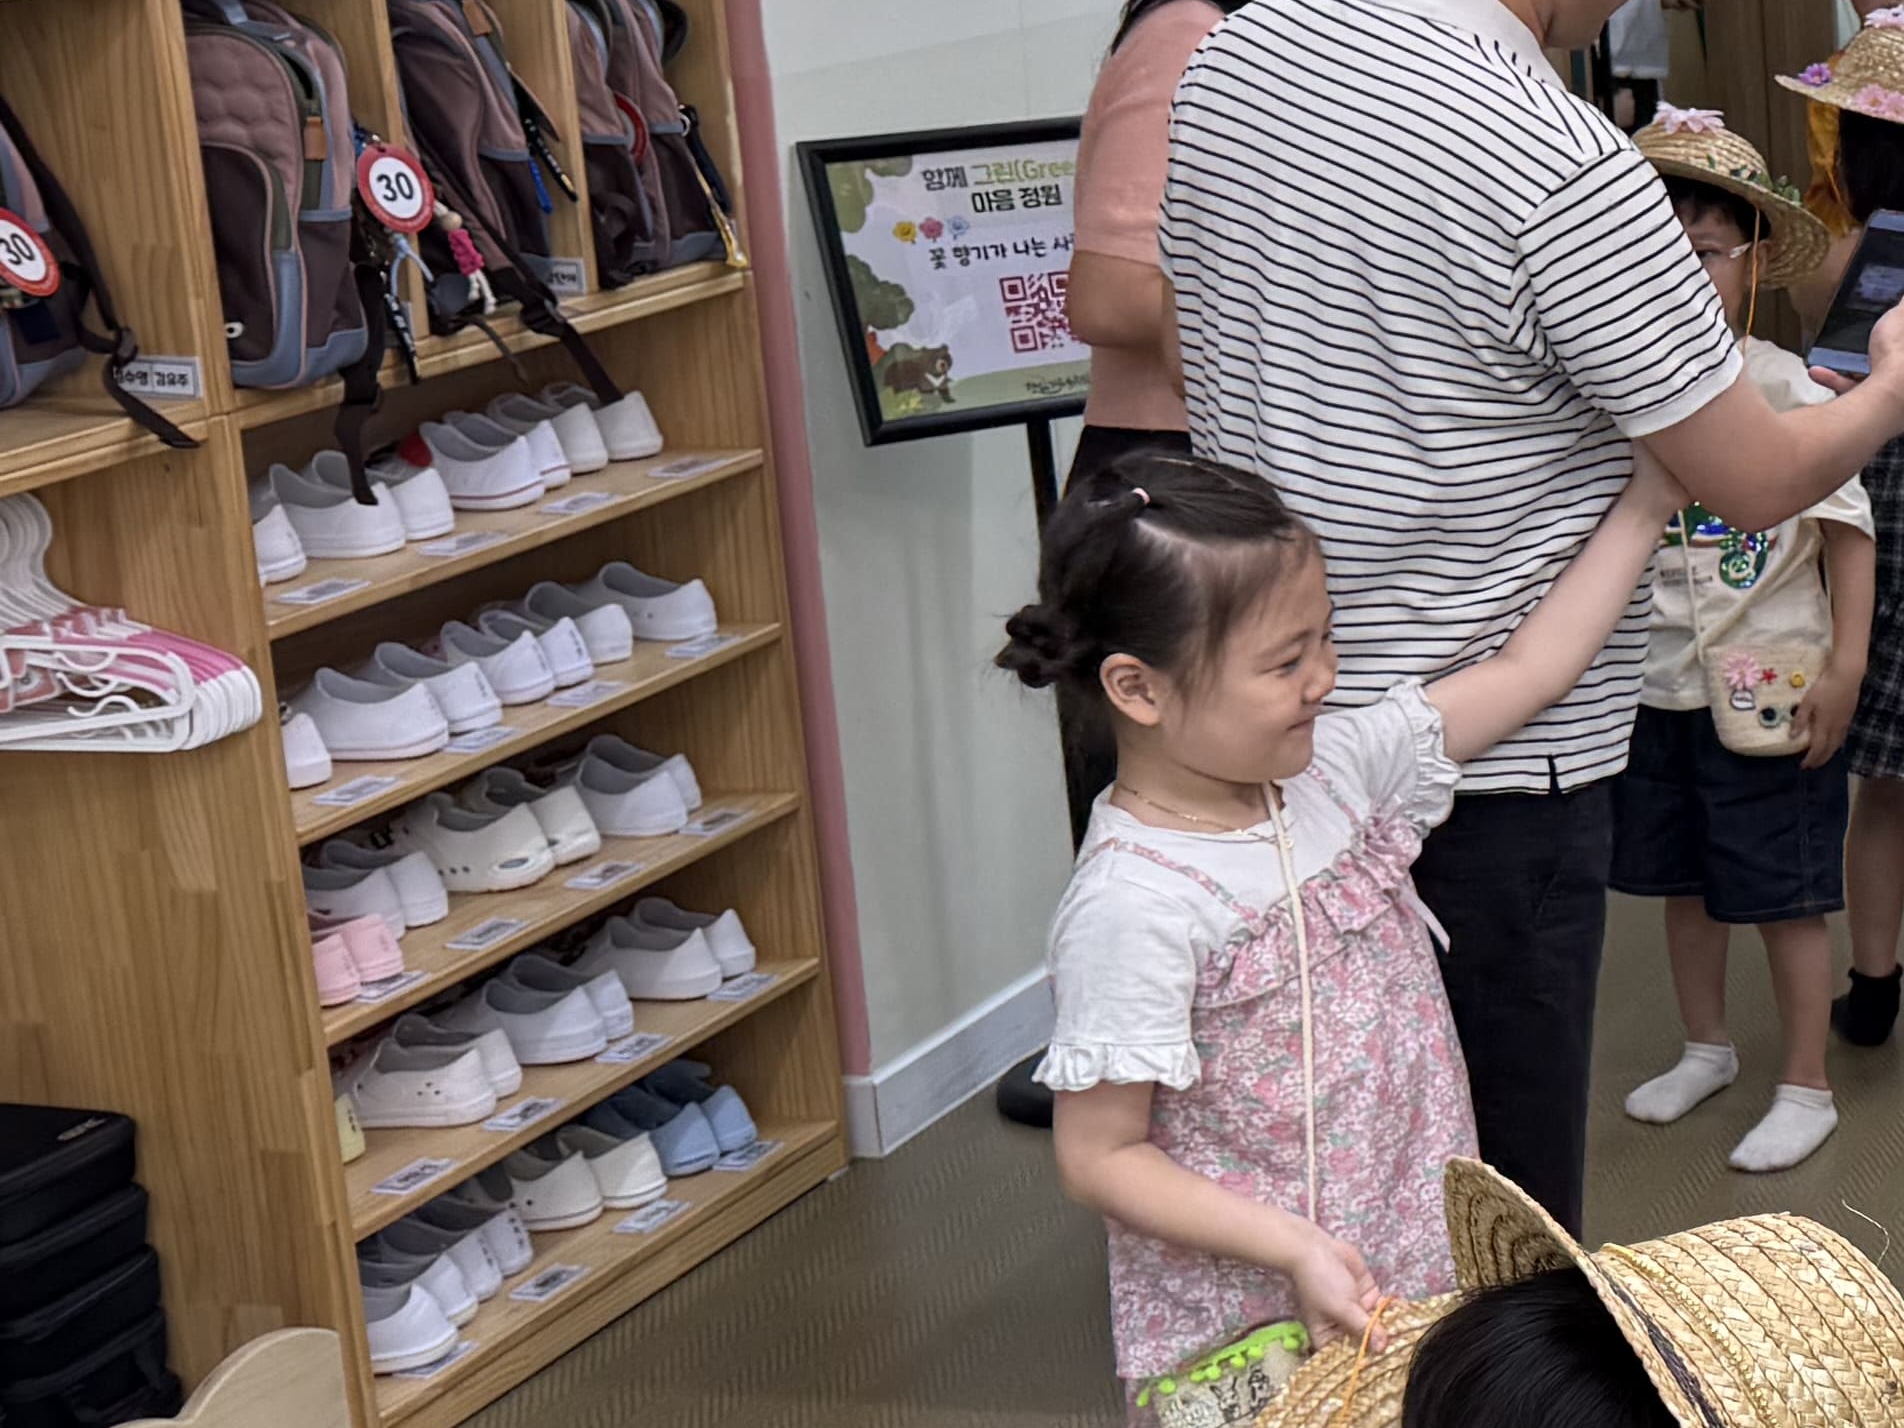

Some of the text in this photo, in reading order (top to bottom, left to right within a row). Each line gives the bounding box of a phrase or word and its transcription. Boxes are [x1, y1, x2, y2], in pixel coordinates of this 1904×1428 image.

[376, 172, 414, 202] 30
[922, 165, 968, 192] 함께
[971, 183, 1063, 214] 마음 정원
[0, 232, 36, 266] 30
[929, 232, 1076, 271] 꽃 향기가 나는 사
